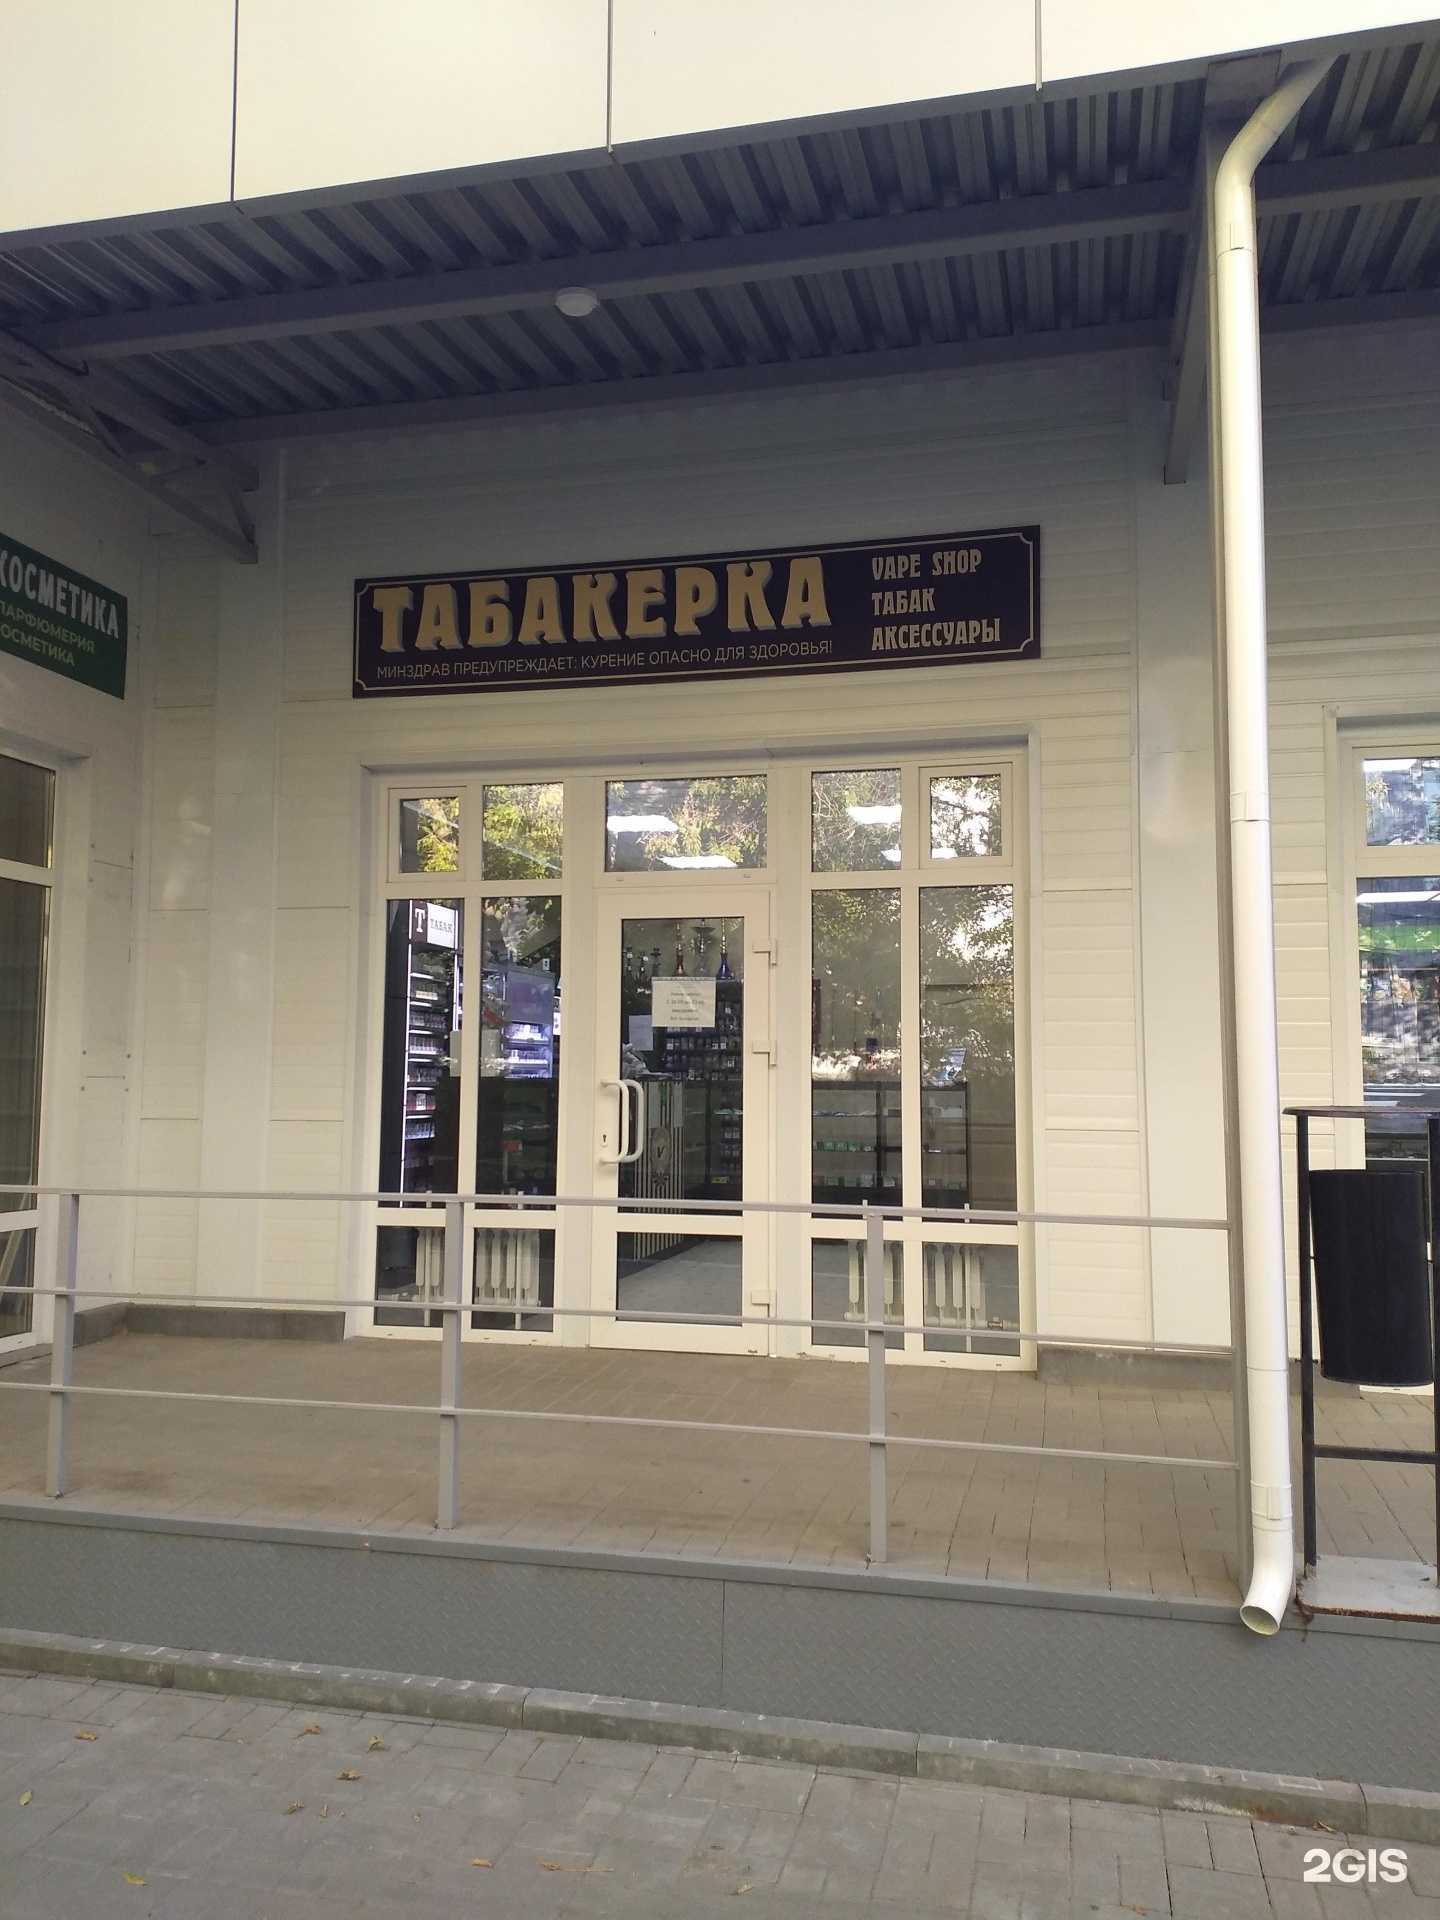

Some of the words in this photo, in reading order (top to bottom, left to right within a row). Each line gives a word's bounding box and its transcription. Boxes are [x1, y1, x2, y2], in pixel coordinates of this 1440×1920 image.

[871, 553, 921, 580] VAPE
[932, 549, 982, 577] SHOP
[0, 550, 119, 639] КОСМЕТИКА
[373, 557, 831, 652] ТАБАКЕРКА
[871, 588, 936, 616] ТАБАК
[0, 623, 75, 667] ОСМЕТИКА
[871, 618, 1001, 651] АКСЕССУАРЫ
[377, 663, 450, 680] МИНЗДРАВ
[454, 656, 577, 675] ПРЕДУПРЕЖДАЕТ:
[582, 652, 645, 668] КУРЕНИЕ
[649, 648, 711, 665] ОПАСНО
[715, 646, 745, 663] ДЛЯ
[749, 640, 833, 660] ЗДОРОВЬЯ!
